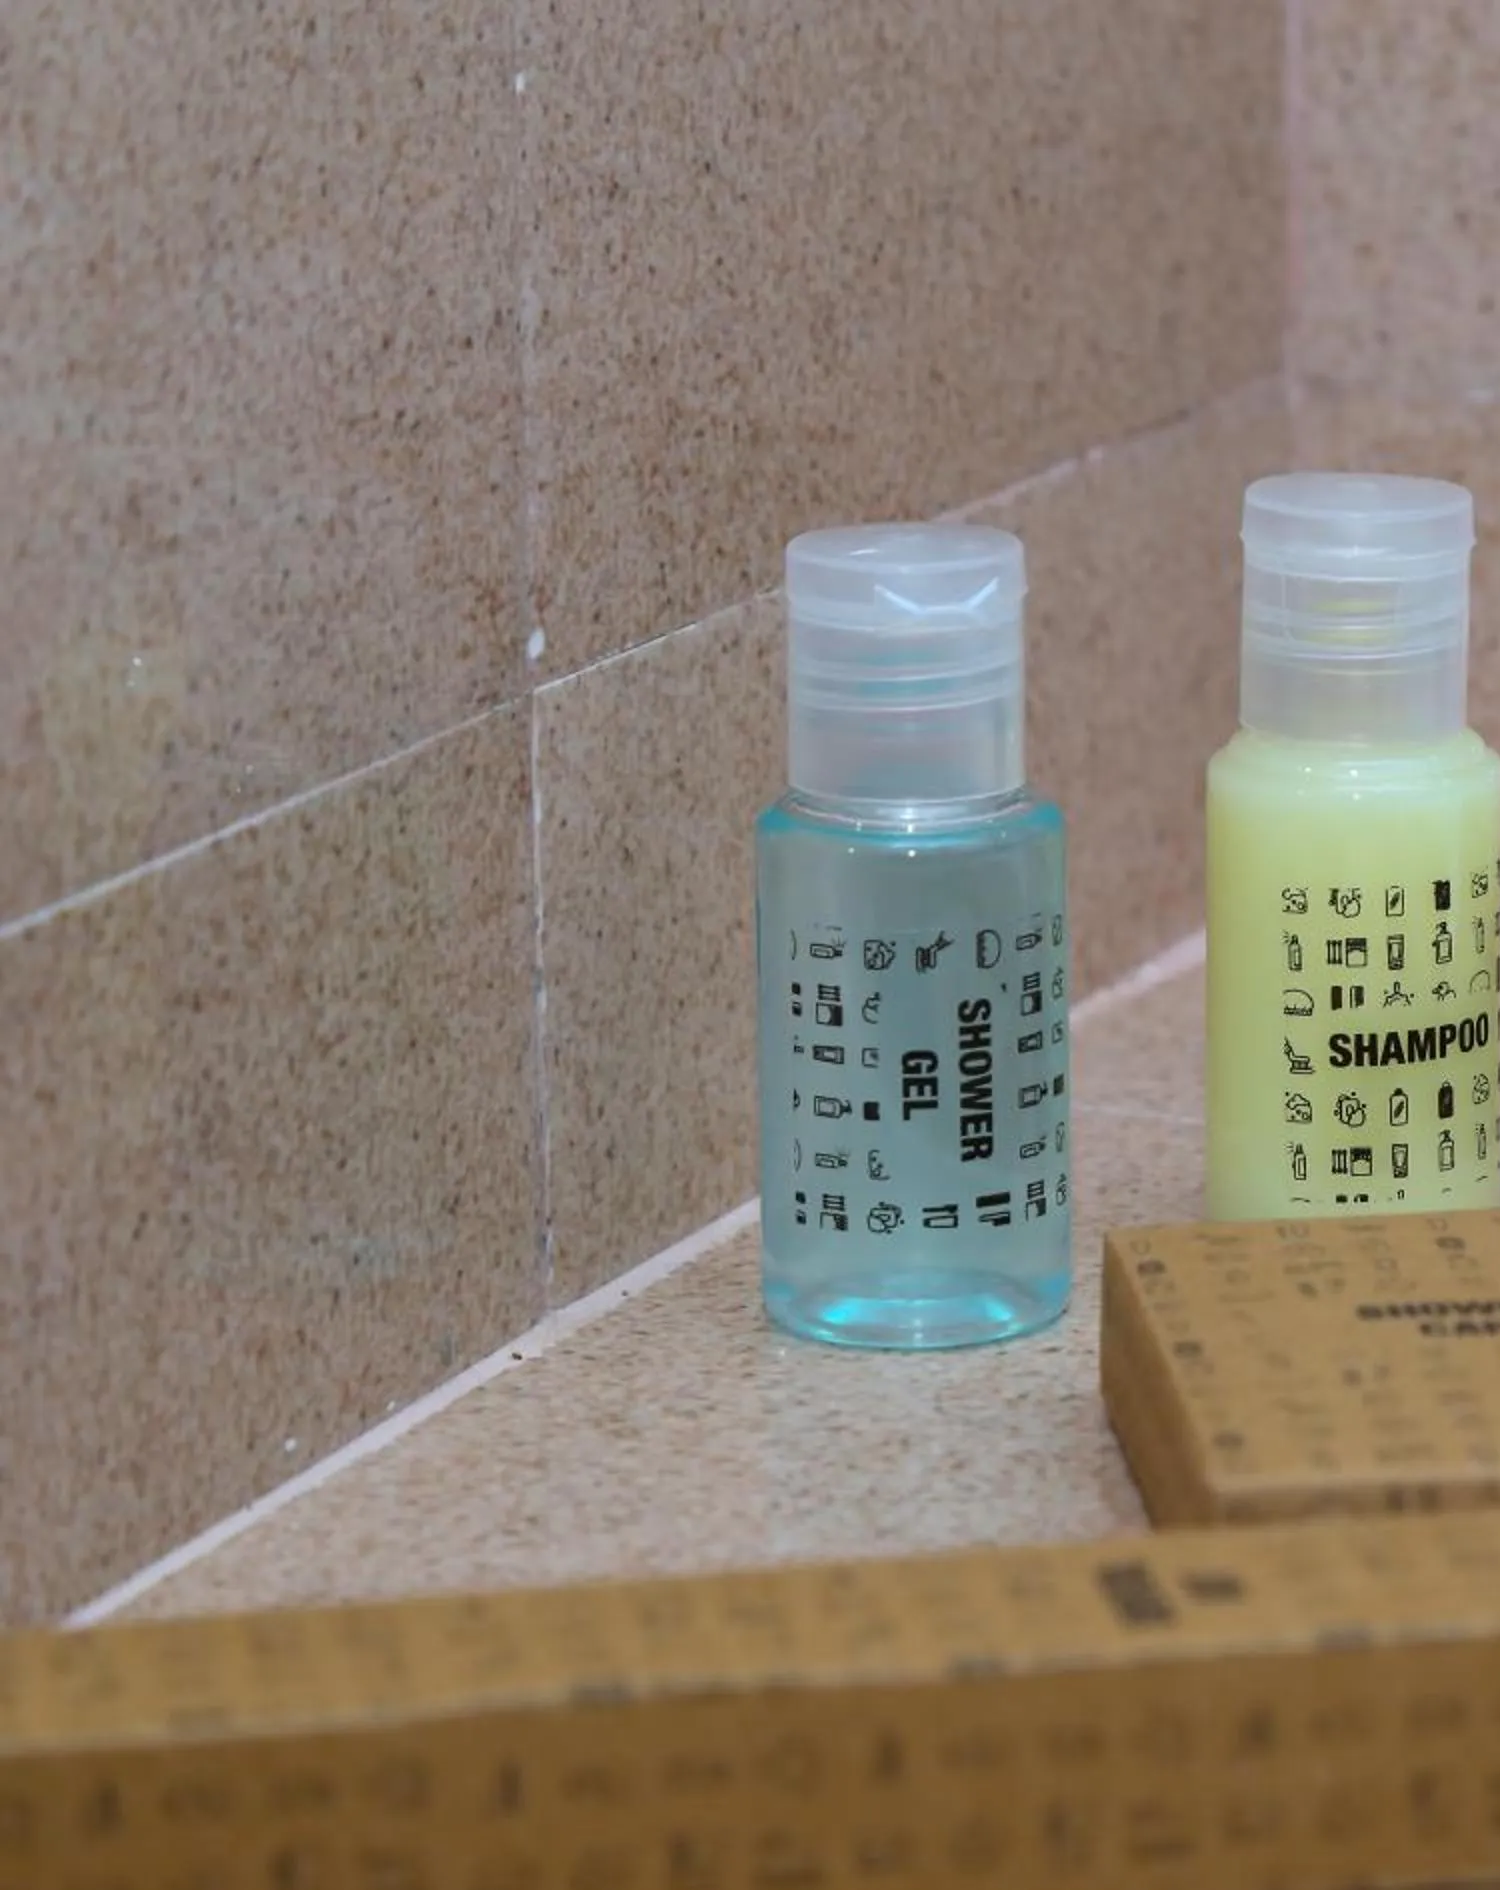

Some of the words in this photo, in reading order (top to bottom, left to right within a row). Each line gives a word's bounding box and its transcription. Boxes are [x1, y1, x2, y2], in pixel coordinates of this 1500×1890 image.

[1328, 1012, 1489, 1068] SHAMPOO
[902, 1050, 939, 1121] GEL
[957, 999, 994, 1162] SHOWER
